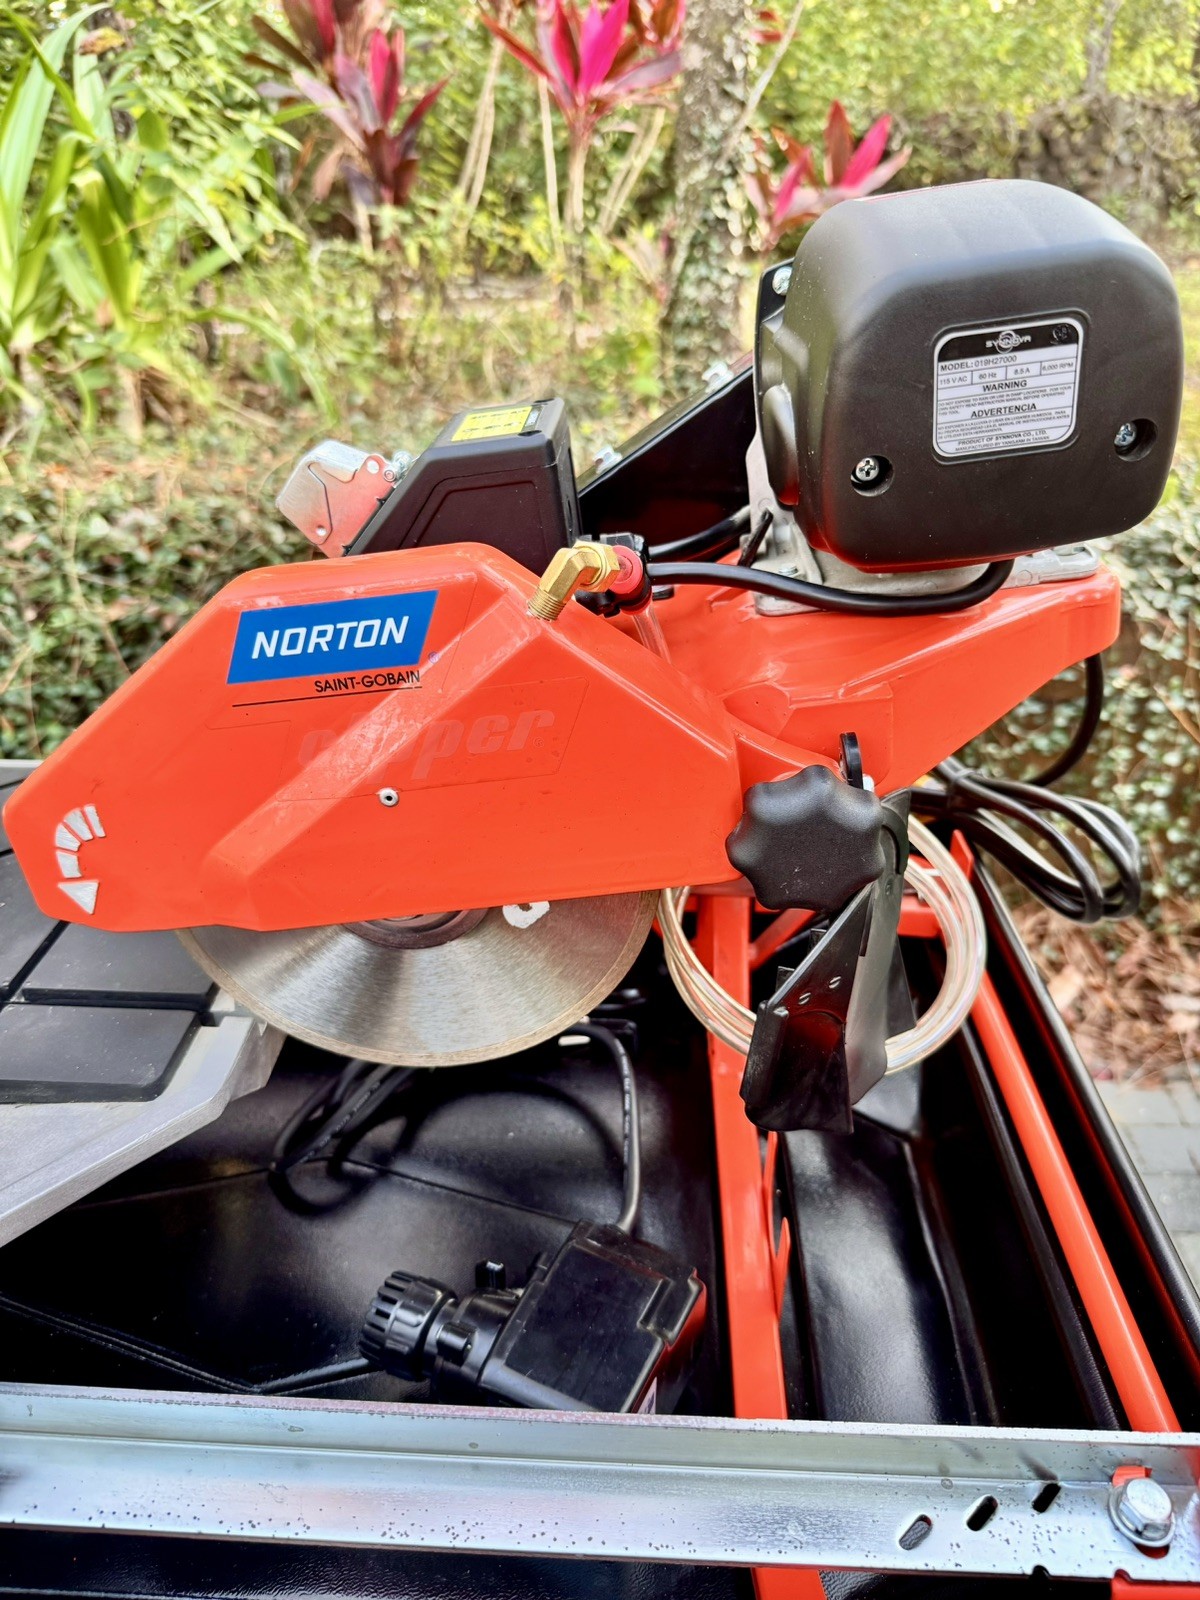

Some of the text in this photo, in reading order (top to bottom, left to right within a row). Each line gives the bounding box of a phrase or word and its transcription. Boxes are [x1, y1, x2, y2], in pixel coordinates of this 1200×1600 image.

[982, 379, 1027, 392] WARNING
[971, 403, 1037, 418] ADVERTENCIA
[252, 615, 409, 659] NORTON
[314, 670, 420, 693] SAINT-GOBAIN
